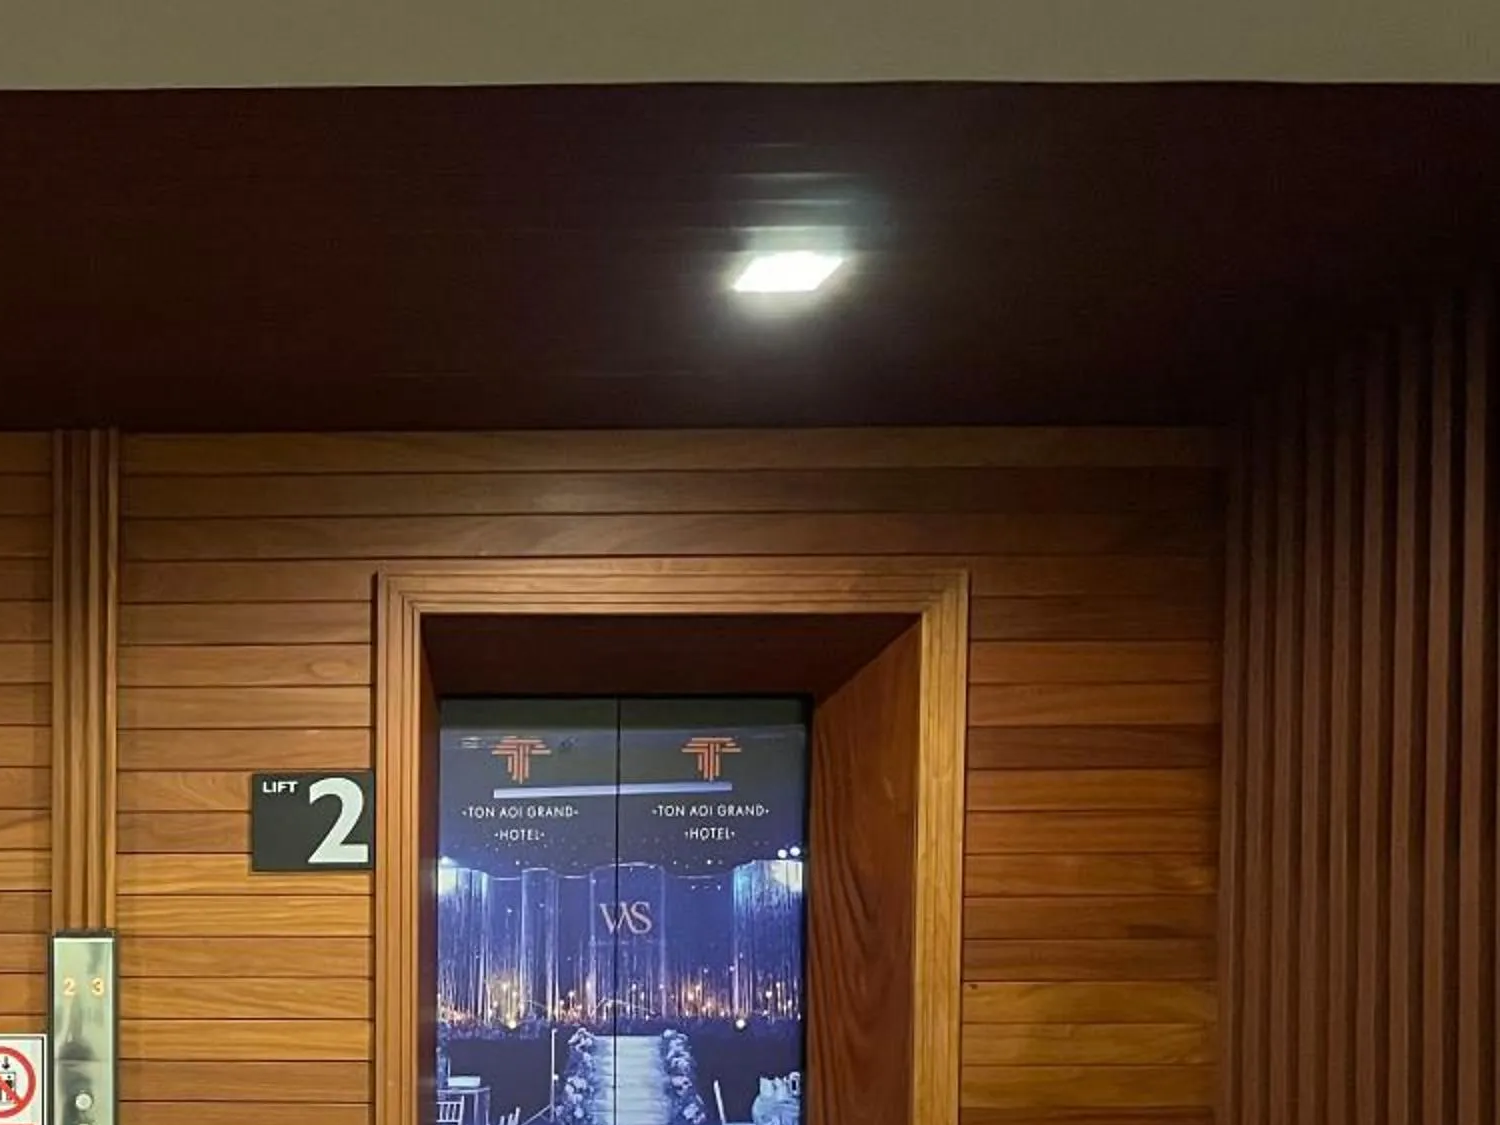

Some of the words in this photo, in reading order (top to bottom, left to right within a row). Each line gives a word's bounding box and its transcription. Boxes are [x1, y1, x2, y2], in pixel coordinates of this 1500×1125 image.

[262, 781, 299, 793] LIFT
[468, 805, 495, 818] TON
[527, 805, 573, 818] GRAND
[657, 804, 685, 817] TON
[717, 804, 765, 817] GRAND
[307, 776, 369, 864] 2
[499, 828, 539, 841] HOTEL
[689, 827, 730, 841] HOTEL
[63, 977, 75, 996] 2
